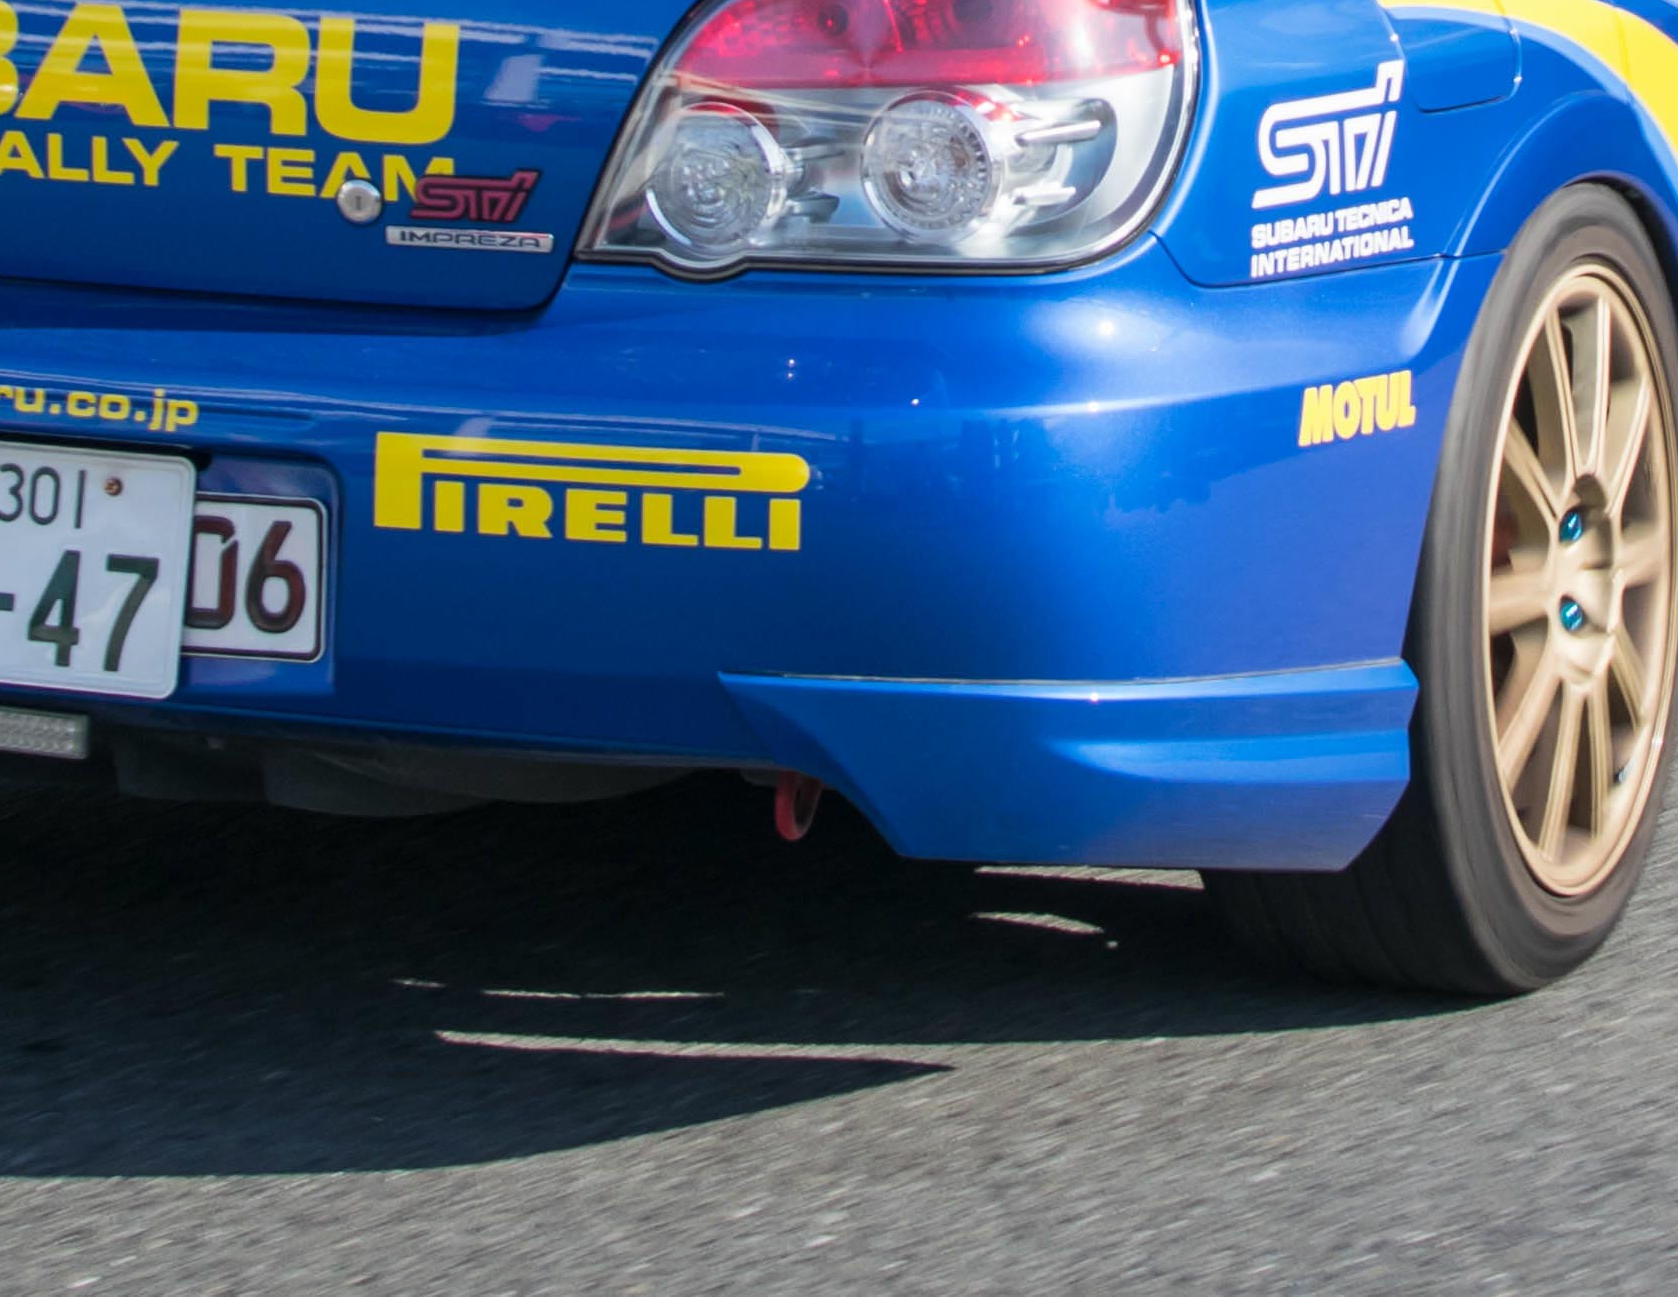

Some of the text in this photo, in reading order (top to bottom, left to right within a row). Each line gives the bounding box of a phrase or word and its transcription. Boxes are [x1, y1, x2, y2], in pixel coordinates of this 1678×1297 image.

[399, 230, 541, 248] IMPREZA
[1251, 197, 1413, 250] SUBARU TECNICA
[1251, 224, 1415, 279] INTERNATIONAL
[1298, 371, 1416, 448] MOTUL
[373, 431, 811, 551] PIRELLI
